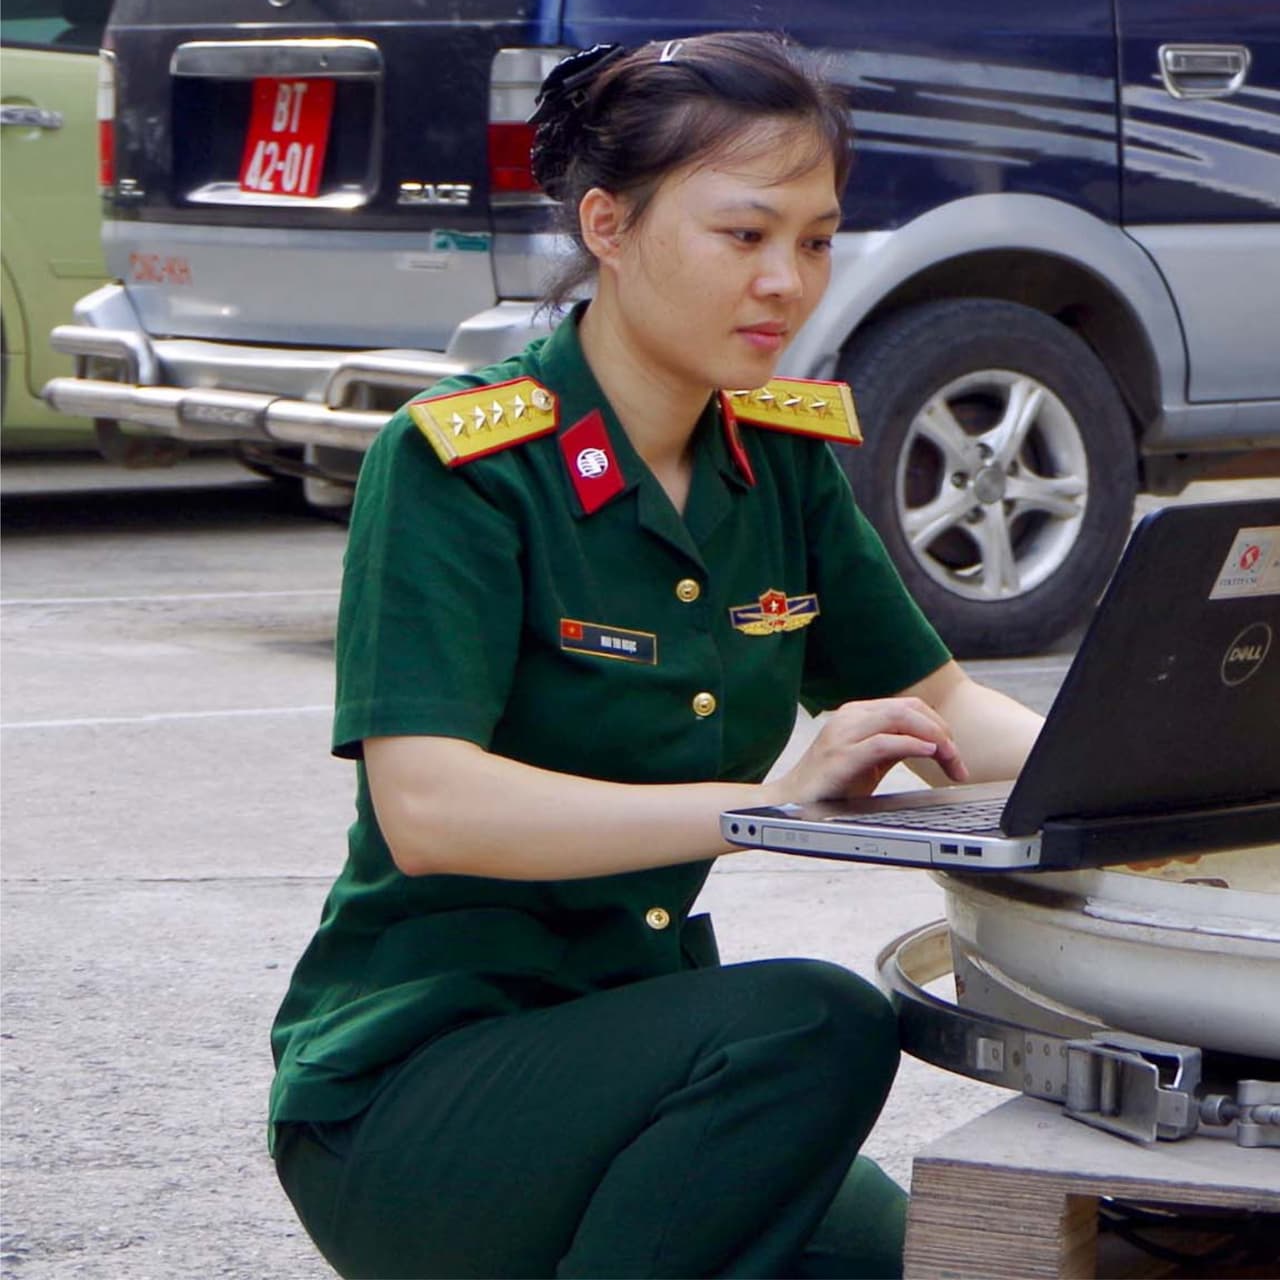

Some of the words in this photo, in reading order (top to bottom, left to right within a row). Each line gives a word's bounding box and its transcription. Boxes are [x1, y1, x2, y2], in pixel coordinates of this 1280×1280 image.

[271, 81, 308, 133] BT
[244, 139, 315, 194] 42-01
[1229, 645, 1263, 661] DELL
